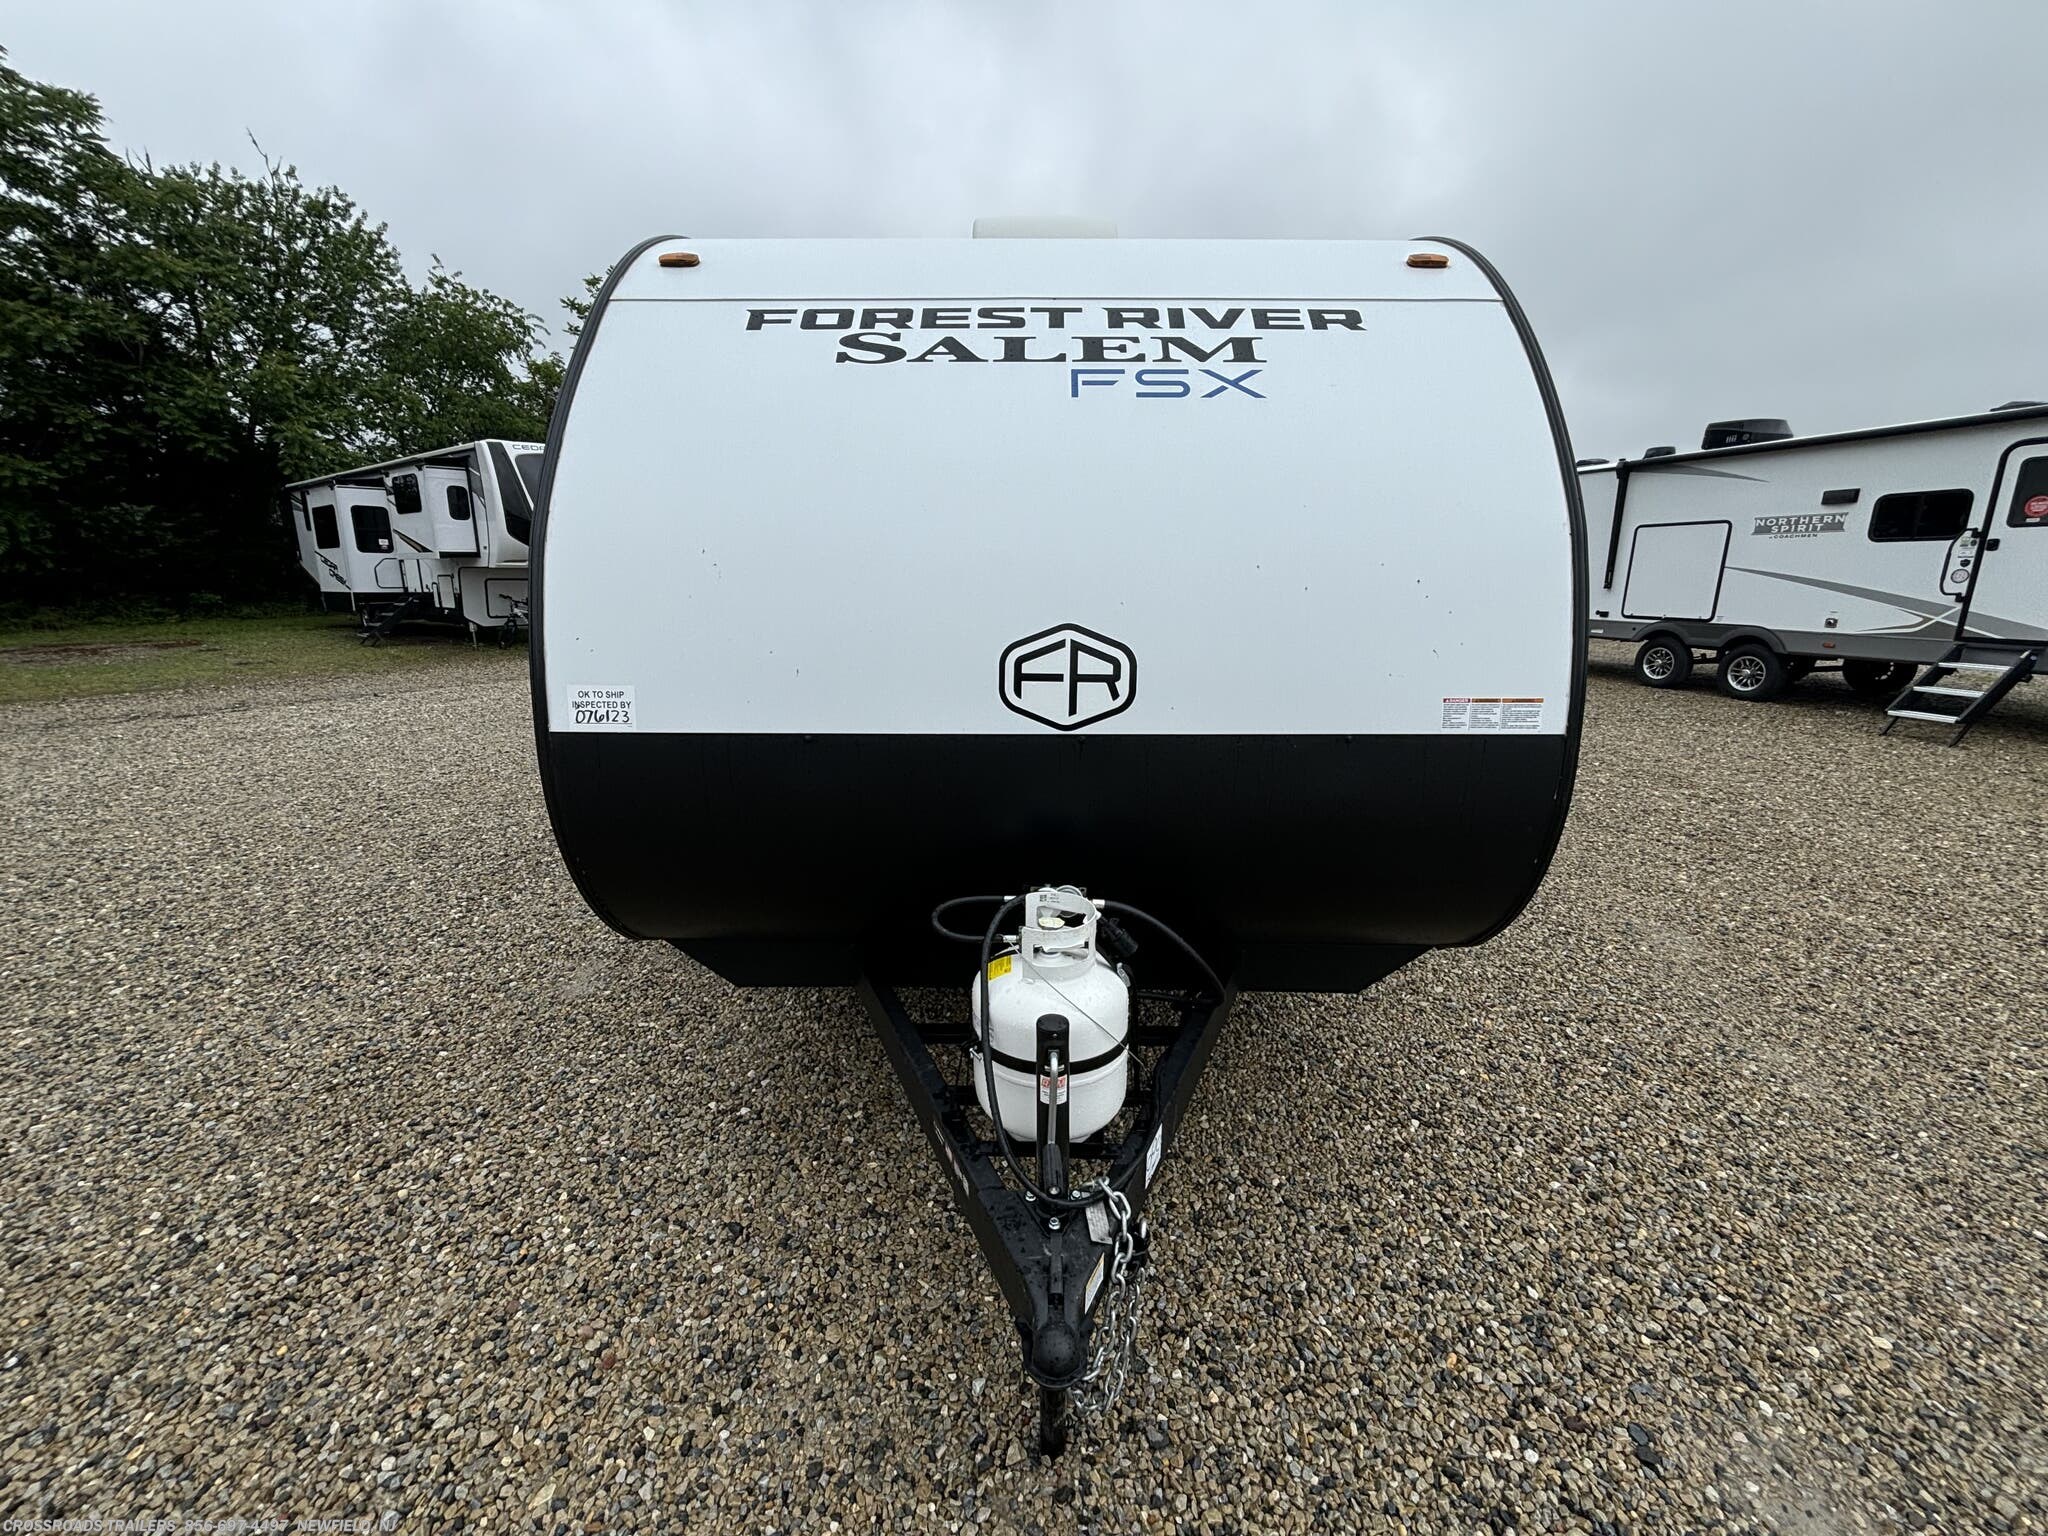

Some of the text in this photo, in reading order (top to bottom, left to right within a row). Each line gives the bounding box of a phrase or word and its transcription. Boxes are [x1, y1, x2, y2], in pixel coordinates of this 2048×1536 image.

[746, 307, 1368, 331] FOREST RIVER
[835, 332, 1268, 365] SALEM
[1071, 368, 1268, 399] FSX
[1755, 514, 1847, 527] NORTHERN
[1770, 523, 1825, 534] SPIRIT
[577, 690, 625, 699] OK TO SHIP
[571, 700, 632, 709] INSPECTED BY
